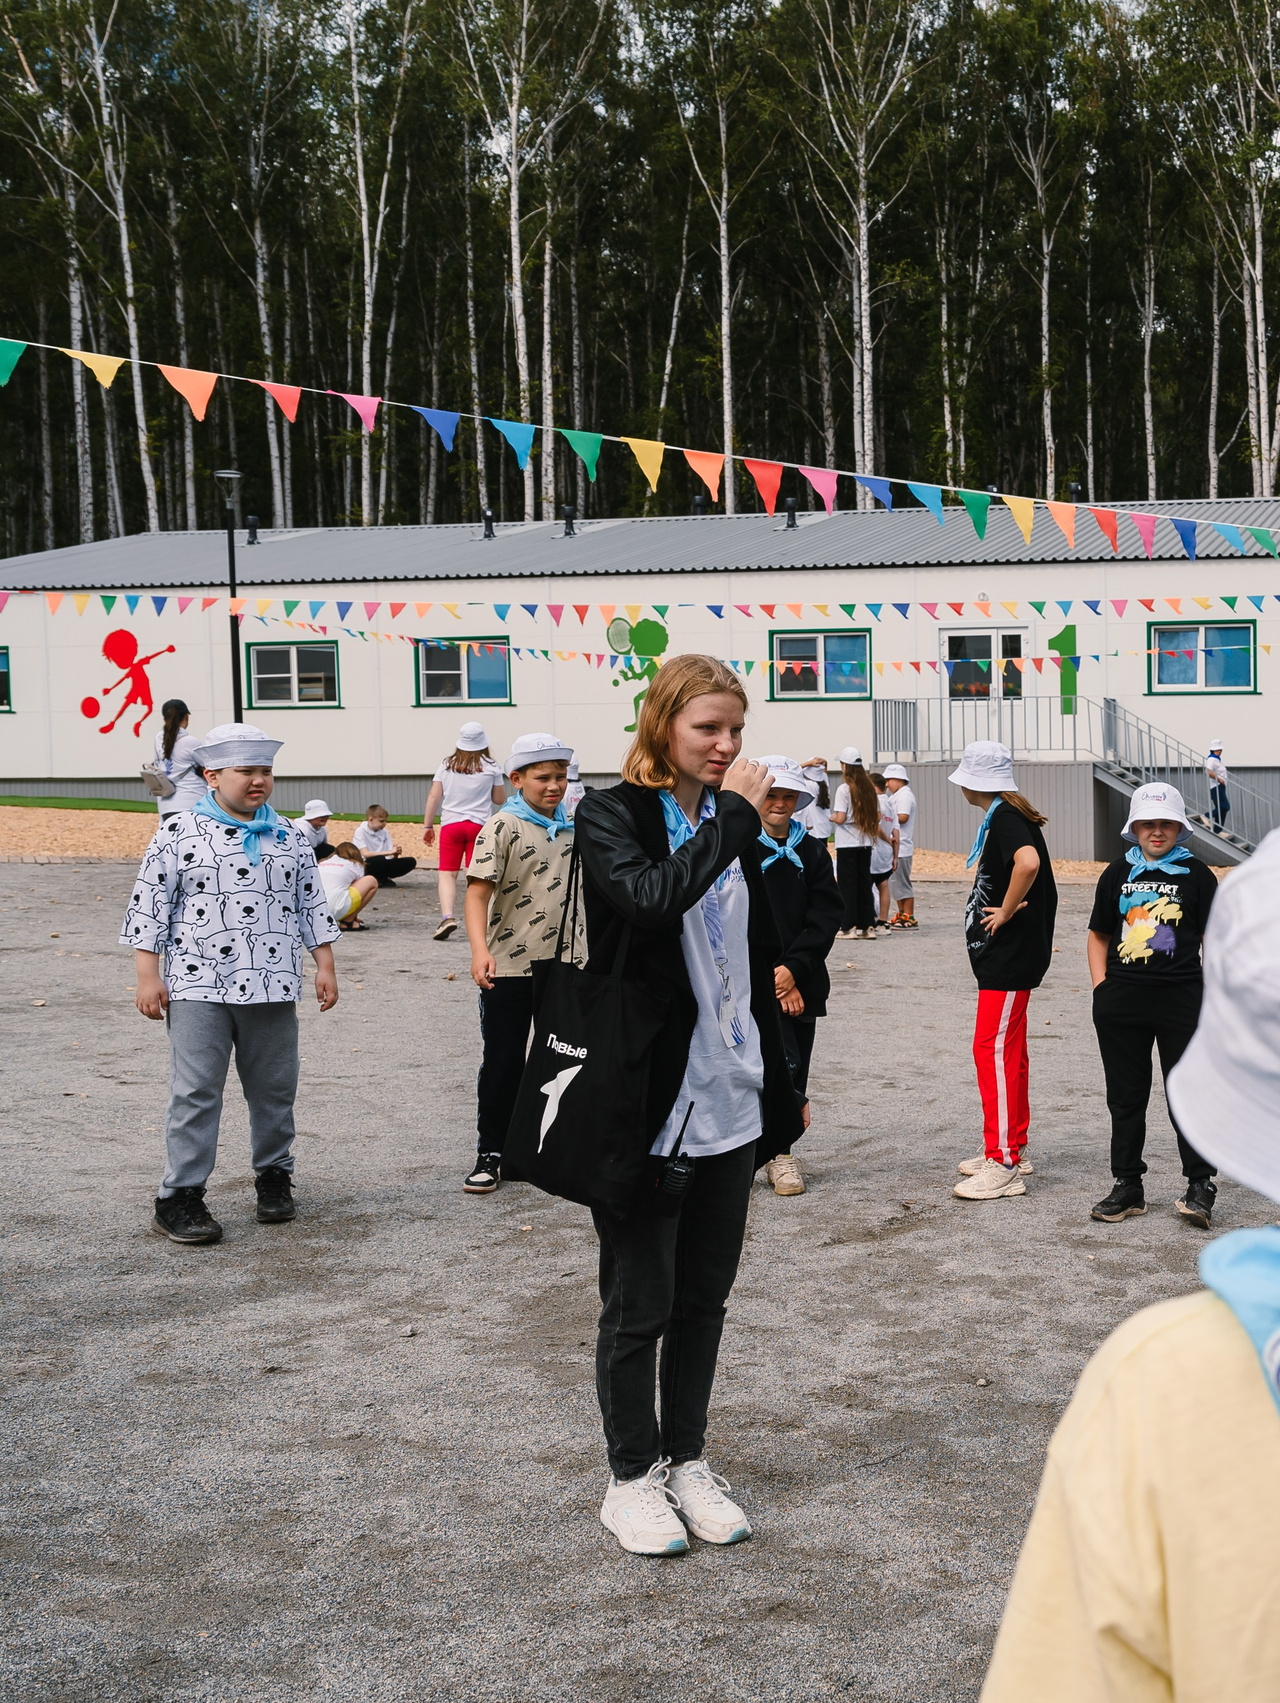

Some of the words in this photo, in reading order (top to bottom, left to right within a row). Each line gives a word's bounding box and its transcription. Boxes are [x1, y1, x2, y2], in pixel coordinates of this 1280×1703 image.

[1048, 625, 1077, 715] 1
[1121, 884, 1158, 894] STREET
[1158, 885, 1179, 895] ART
